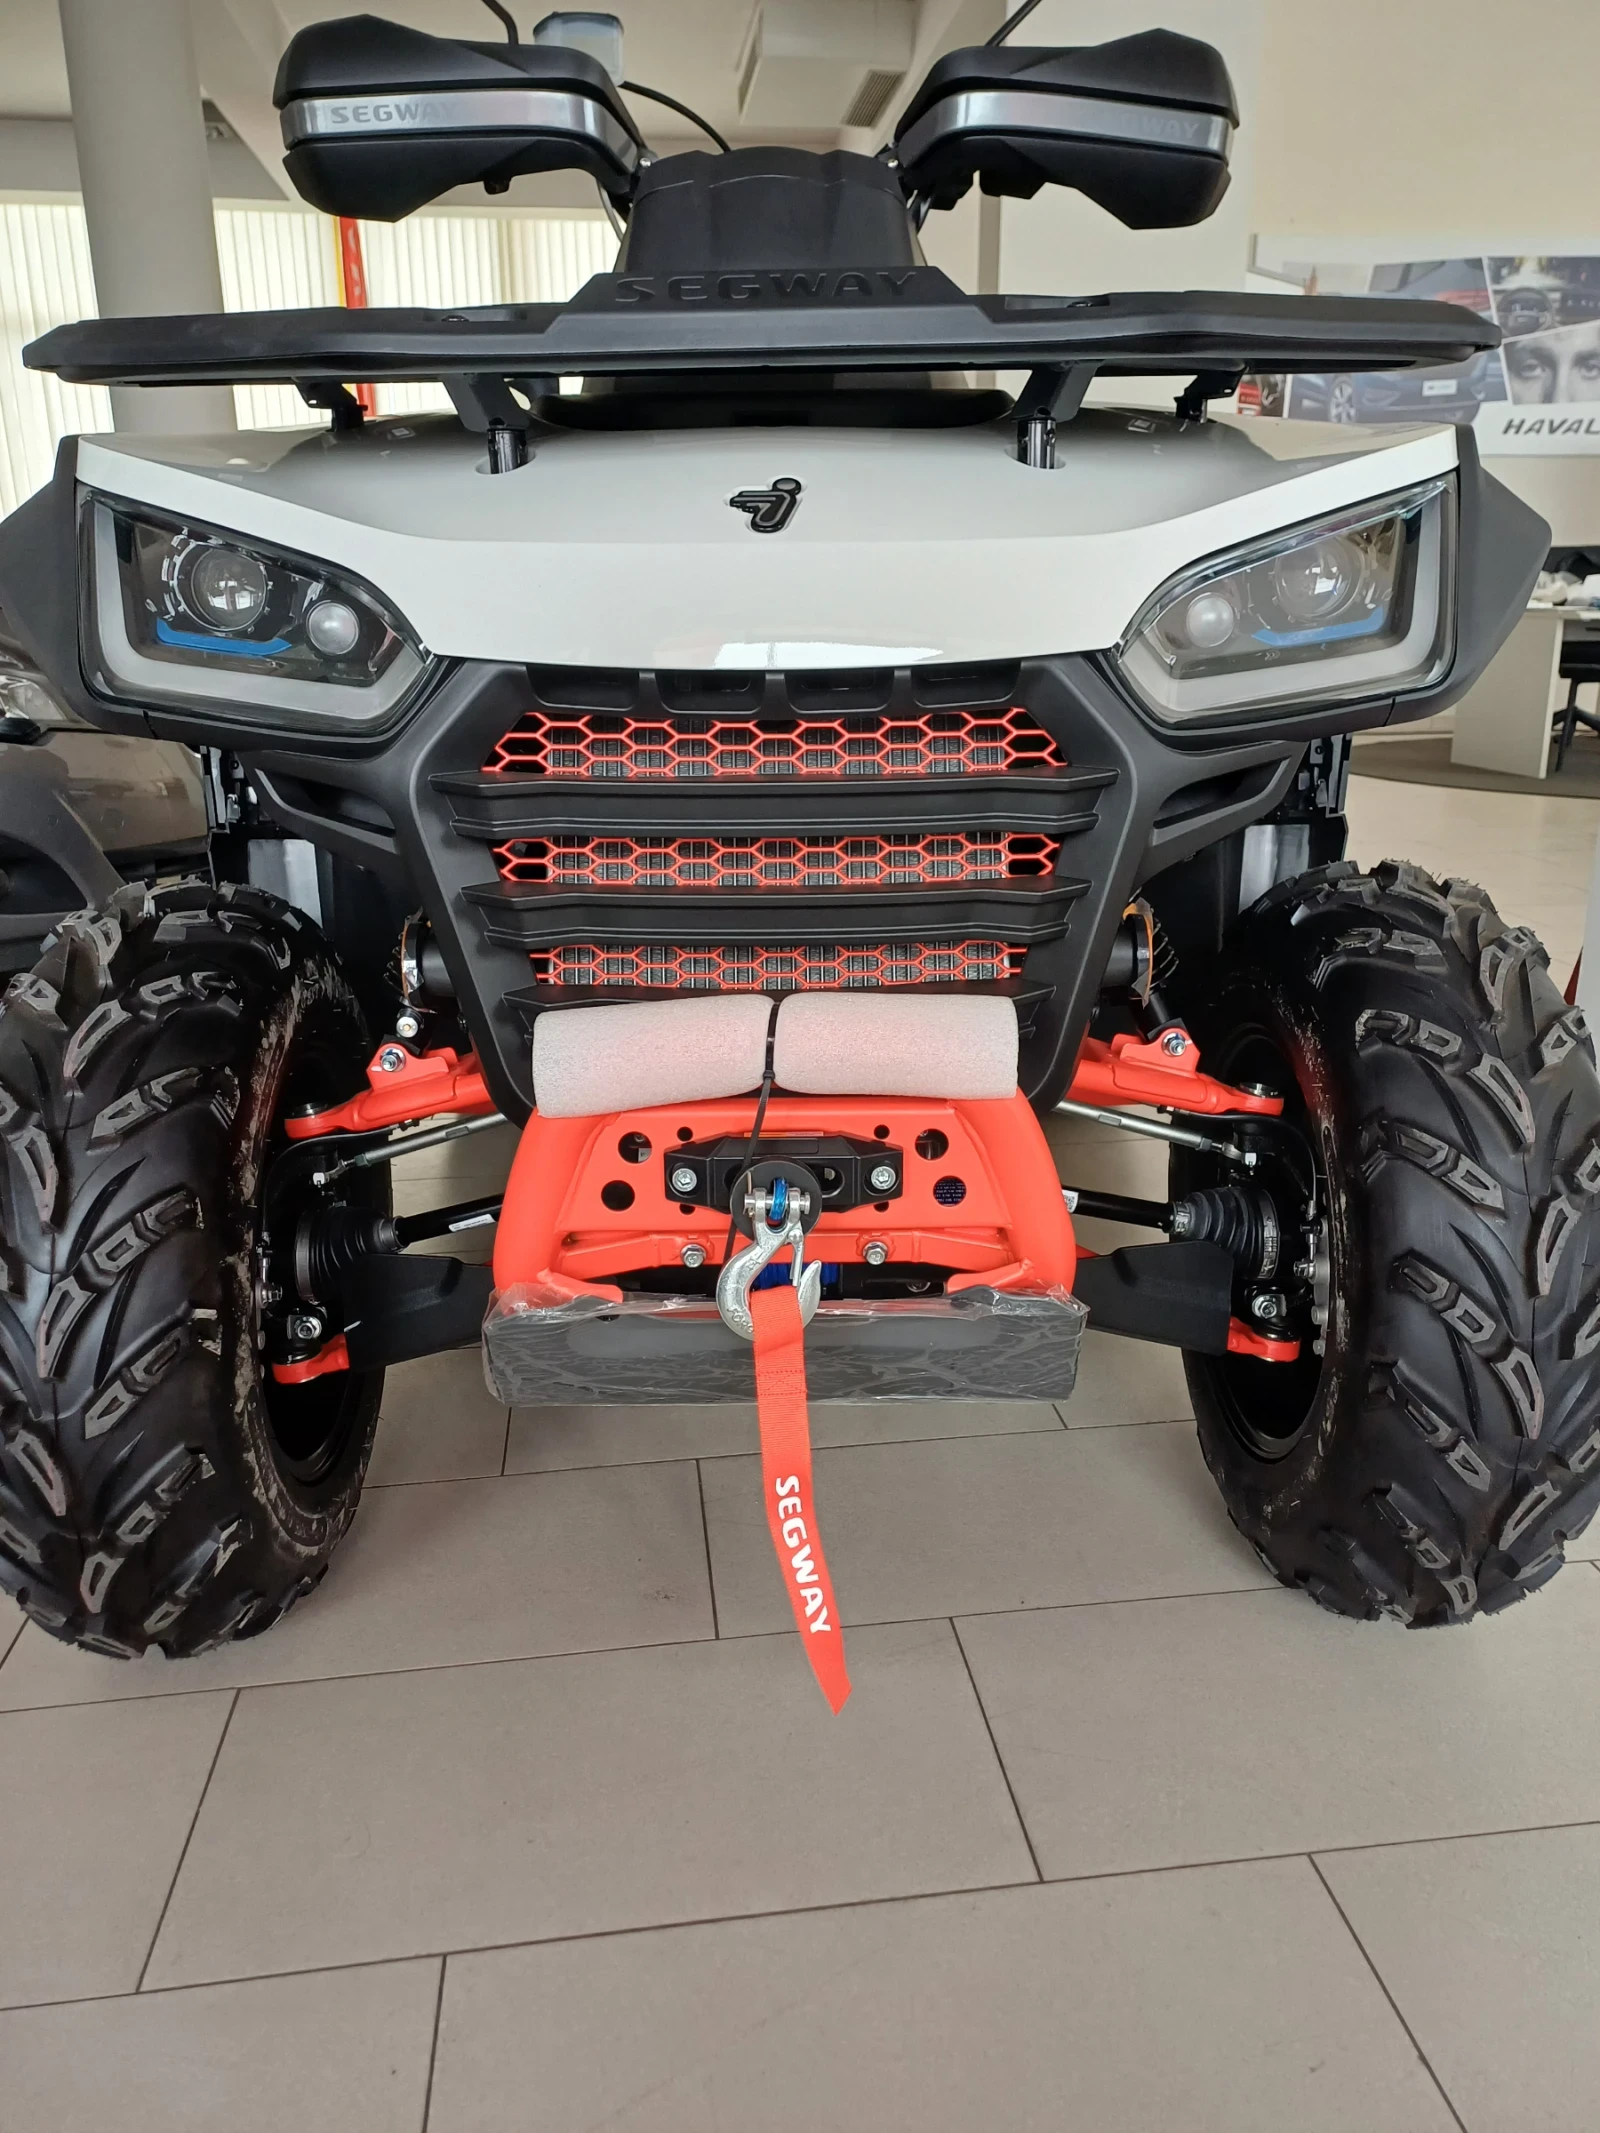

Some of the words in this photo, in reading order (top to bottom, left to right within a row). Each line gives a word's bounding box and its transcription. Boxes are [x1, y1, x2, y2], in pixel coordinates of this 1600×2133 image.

[331, 101, 457, 125] SEGWAY
[614, 271, 917, 302] SEGWAY
[1502, 417, 1600, 436] HAVAL
[775, 1475, 832, 1634] SEGWAY
